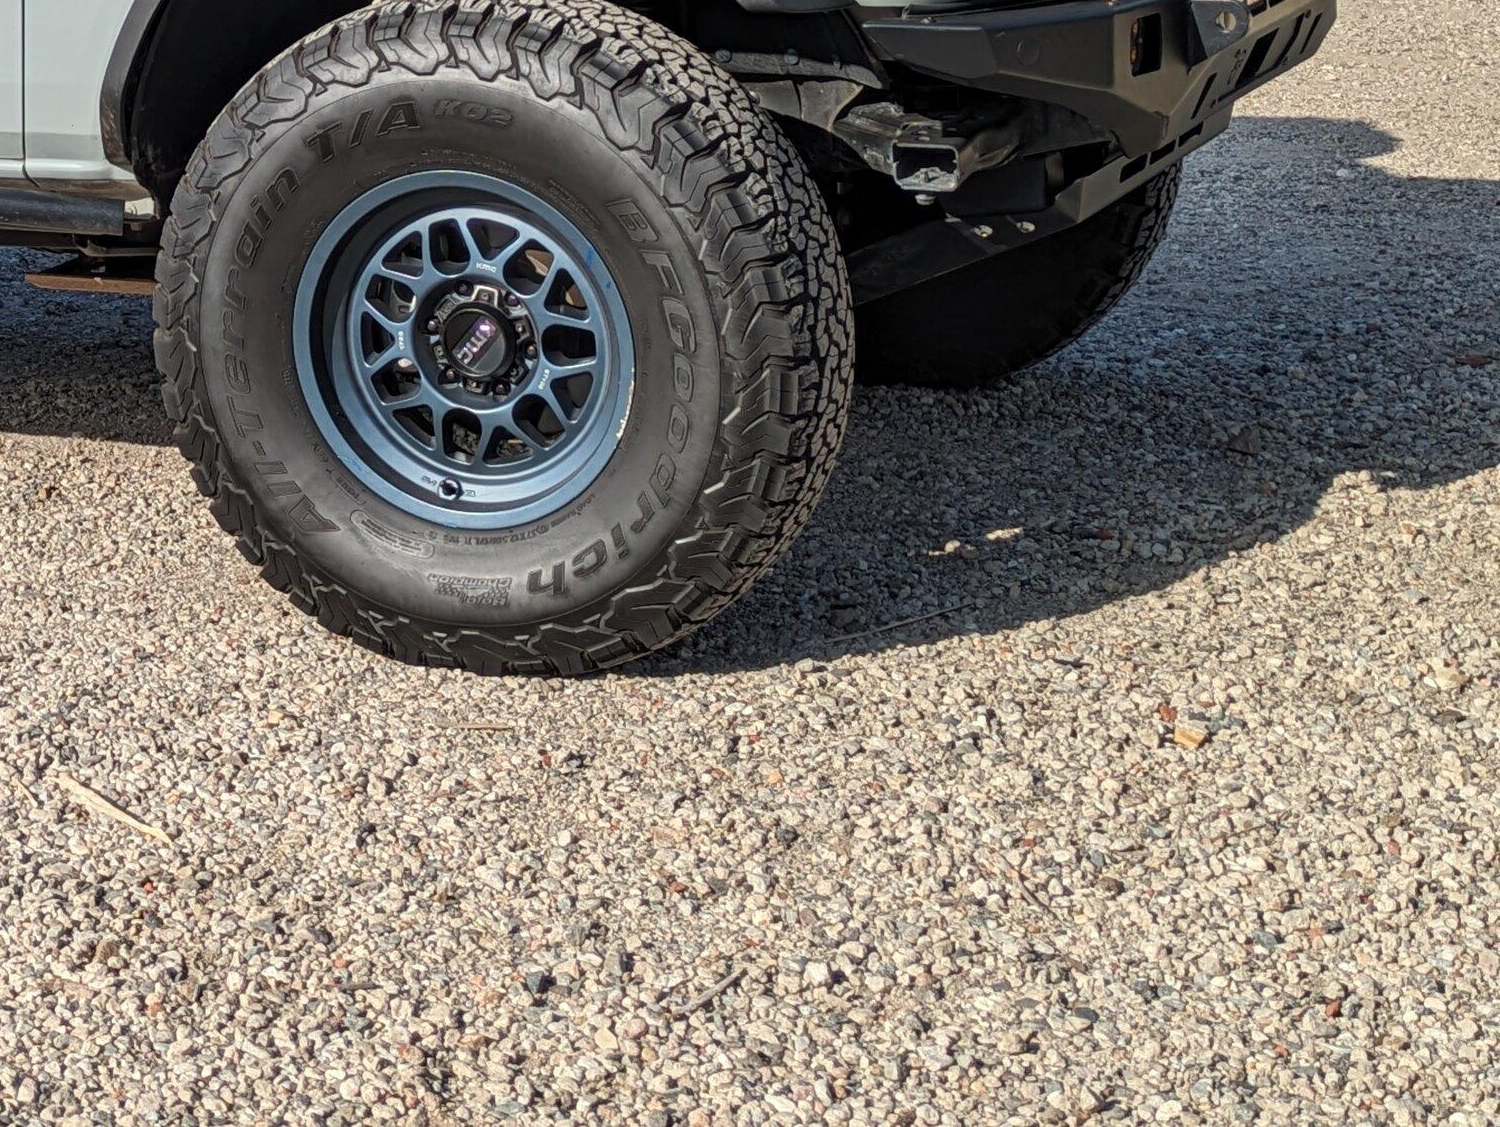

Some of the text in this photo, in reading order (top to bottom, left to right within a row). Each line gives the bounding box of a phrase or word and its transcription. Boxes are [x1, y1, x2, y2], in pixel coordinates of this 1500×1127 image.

[302, 100, 421, 164] T/A
[434, 98, 515, 130] KO2
[526, 199, 697, 596] BFGoodrich
